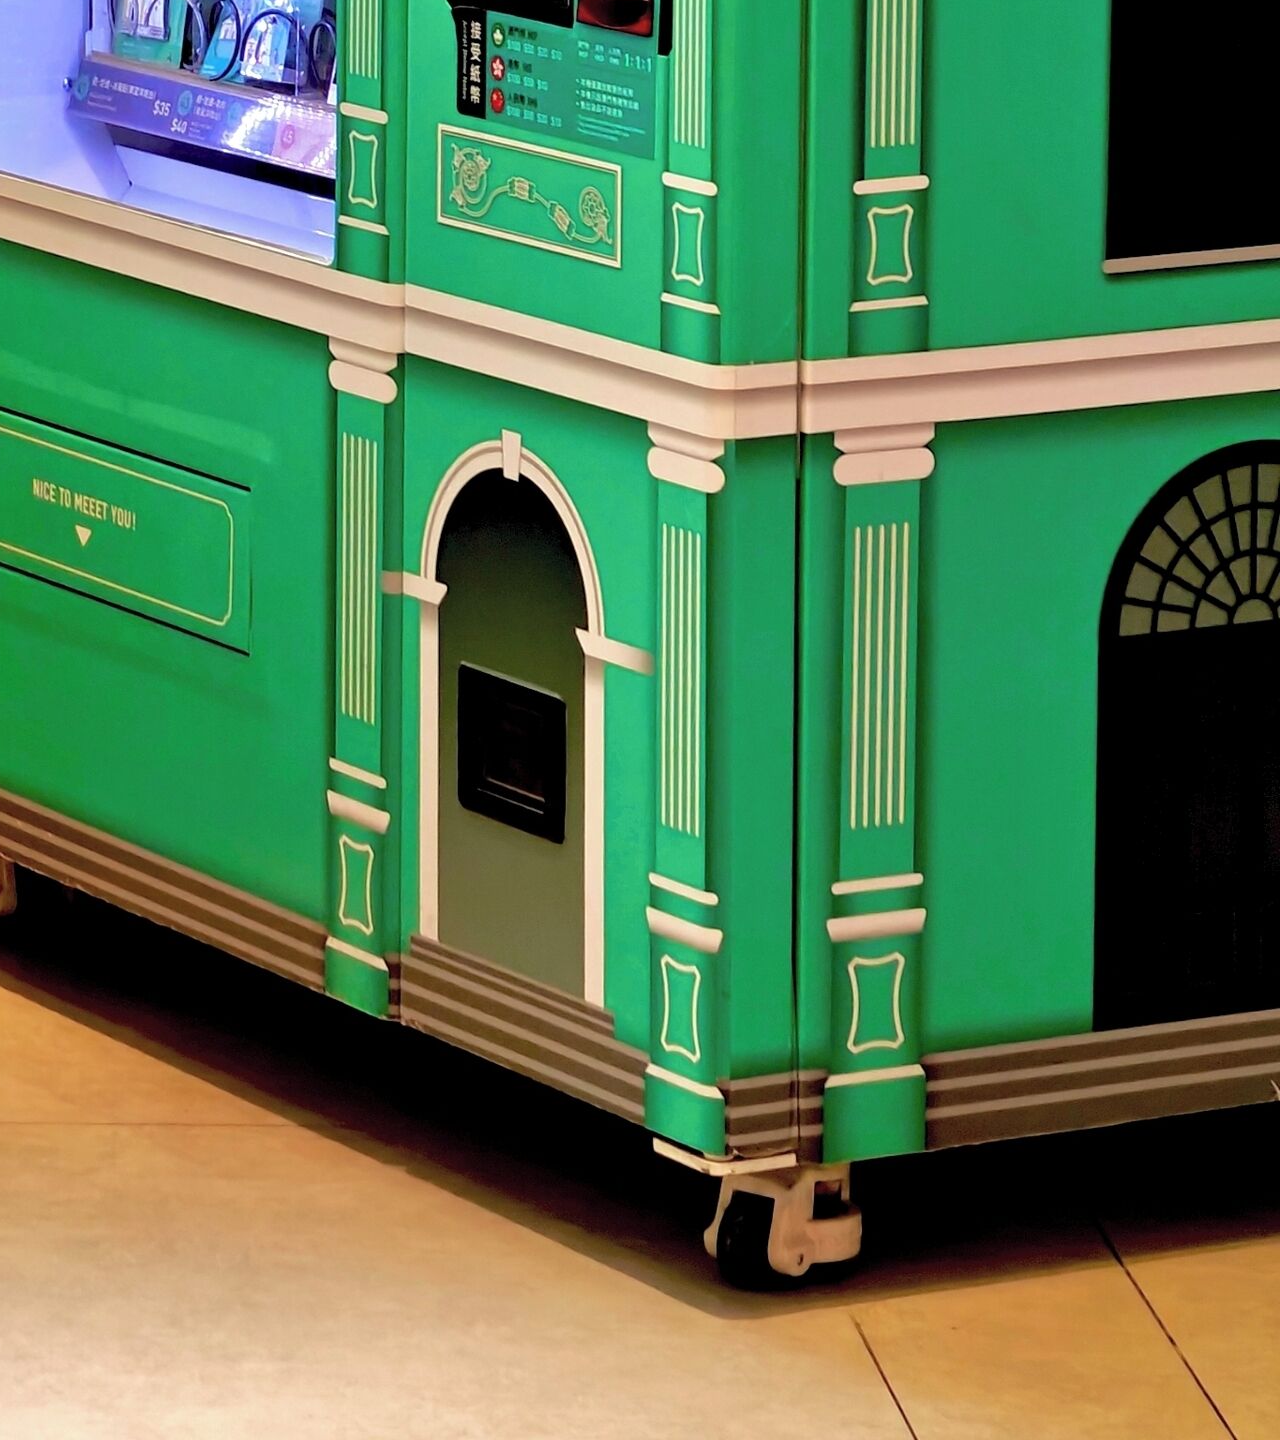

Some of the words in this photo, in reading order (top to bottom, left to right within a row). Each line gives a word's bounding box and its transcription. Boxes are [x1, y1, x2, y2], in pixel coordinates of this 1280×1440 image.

[32, 477, 57, 503] NICE
[59, 486, 72, 509] TO
[74, 492, 108, 521] MEEET
[111, 504, 137, 531] YOU!
